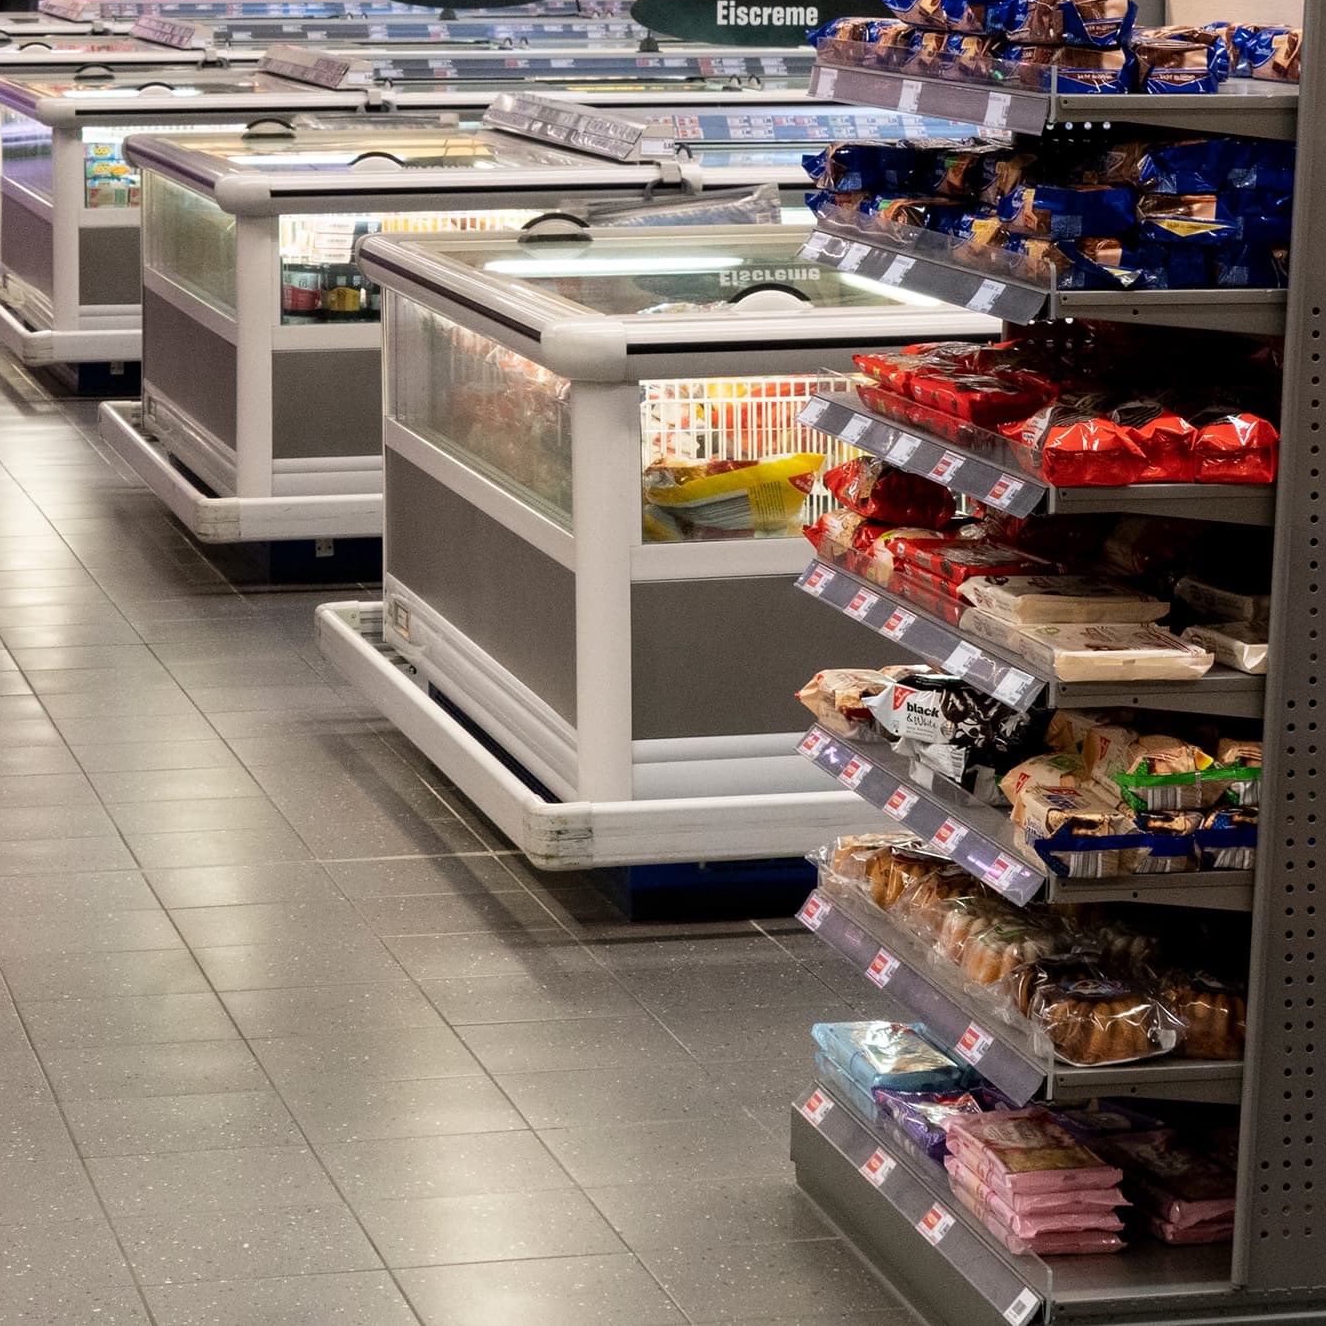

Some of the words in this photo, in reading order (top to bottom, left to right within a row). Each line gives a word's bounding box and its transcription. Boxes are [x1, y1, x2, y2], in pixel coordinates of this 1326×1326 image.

[716, 0, 819, 27] Eiscreme
[906, 701, 941, 719] black
[914, 716, 938, 730] White
